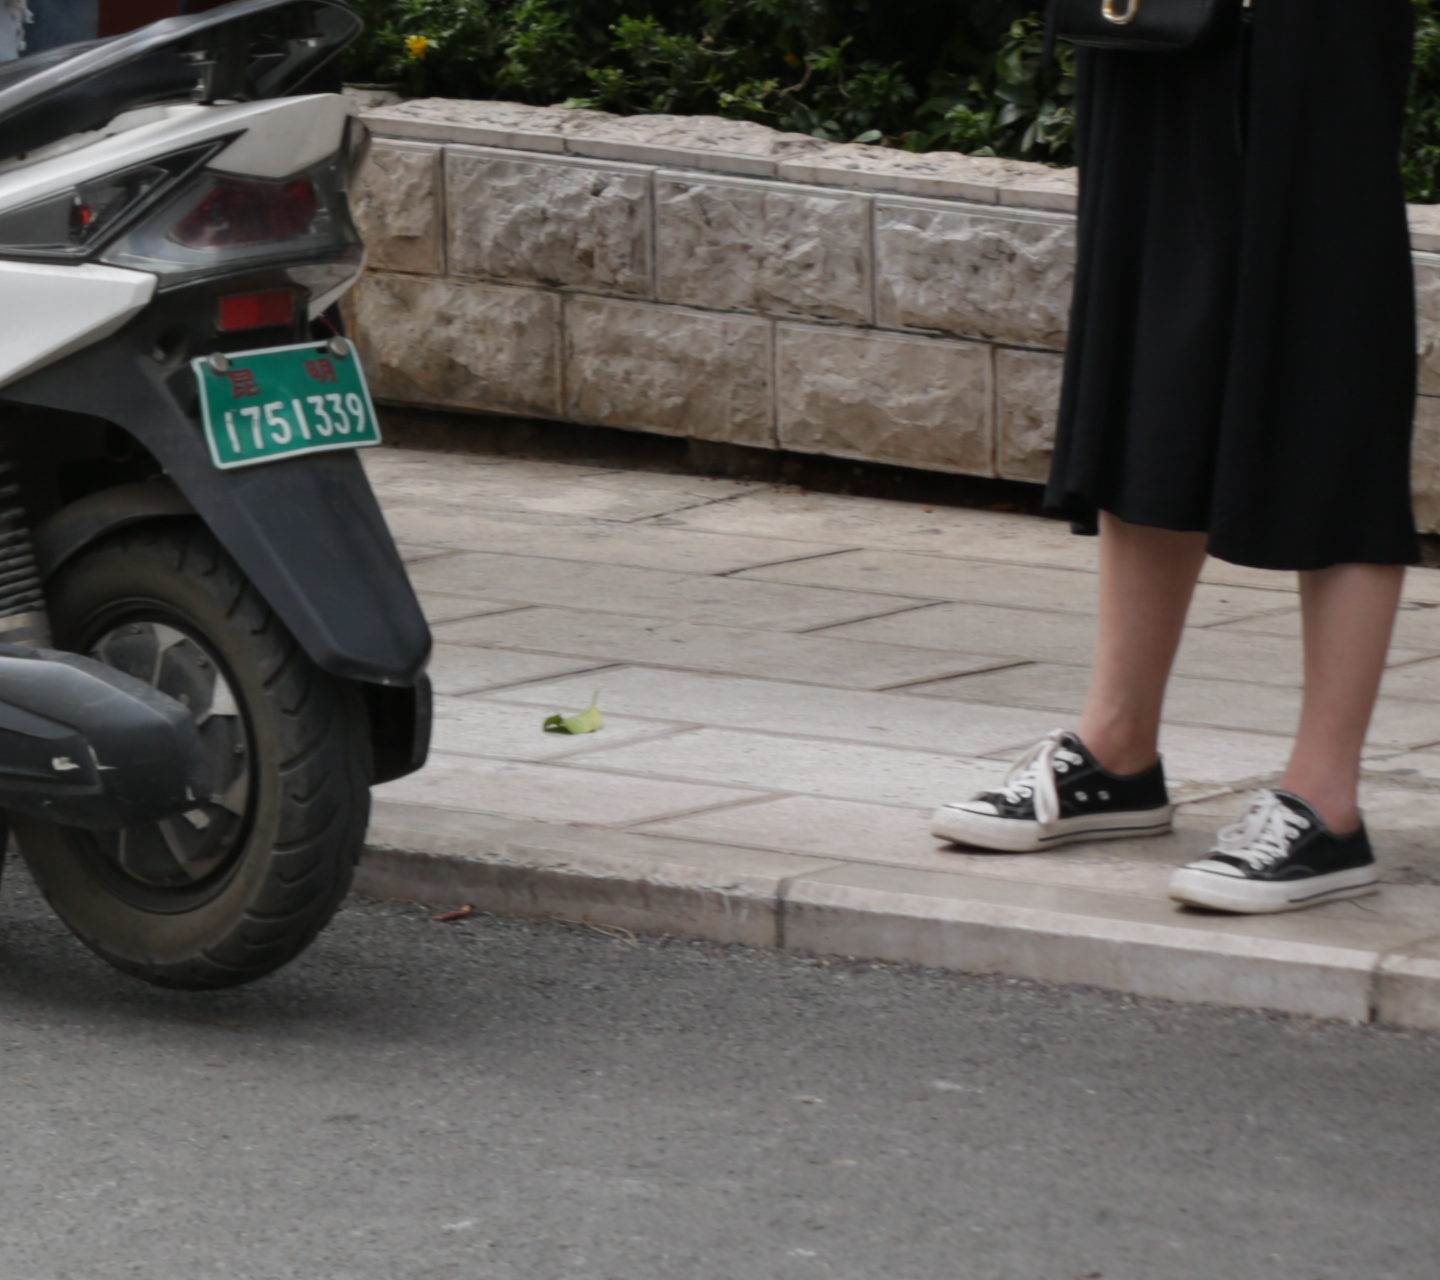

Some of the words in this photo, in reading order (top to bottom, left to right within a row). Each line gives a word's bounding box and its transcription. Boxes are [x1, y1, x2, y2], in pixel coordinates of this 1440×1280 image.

[230, 368, 263, 399] 昆
[303, 357, 338, 384] 明
[224, 392, 366, 454] 1751339
